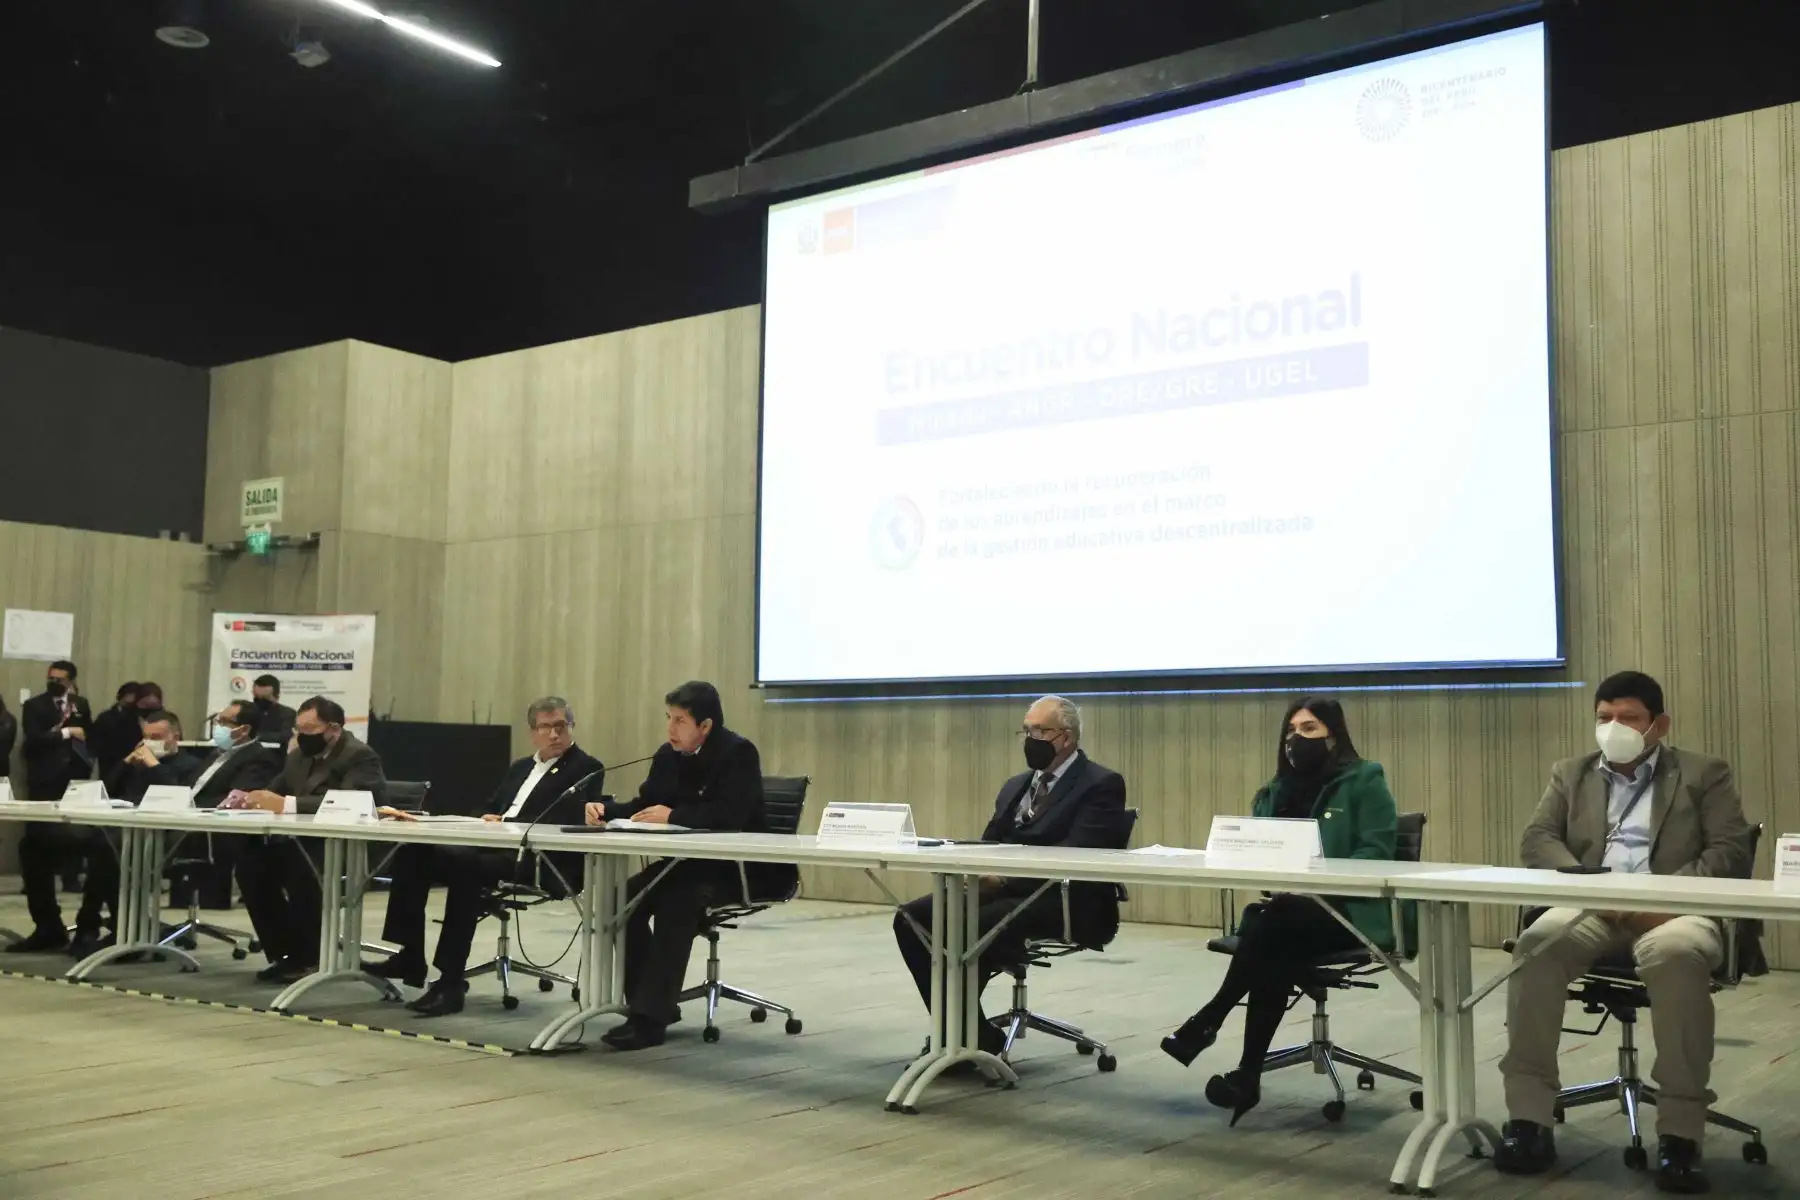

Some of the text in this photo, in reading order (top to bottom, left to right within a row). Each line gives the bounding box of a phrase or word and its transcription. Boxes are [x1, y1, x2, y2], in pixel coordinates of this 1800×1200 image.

[885, 270, 1362, 394] Encuentro Nacional
[1244, 359, 1319, 389] UGEL
[246, 487, 278, 507] SALIDA
[1164, 492, 1228, 513] marco
[1150, 513, 1316, 543] descentralizada
[231, 648, 354, 661] Encuentro Nacional
